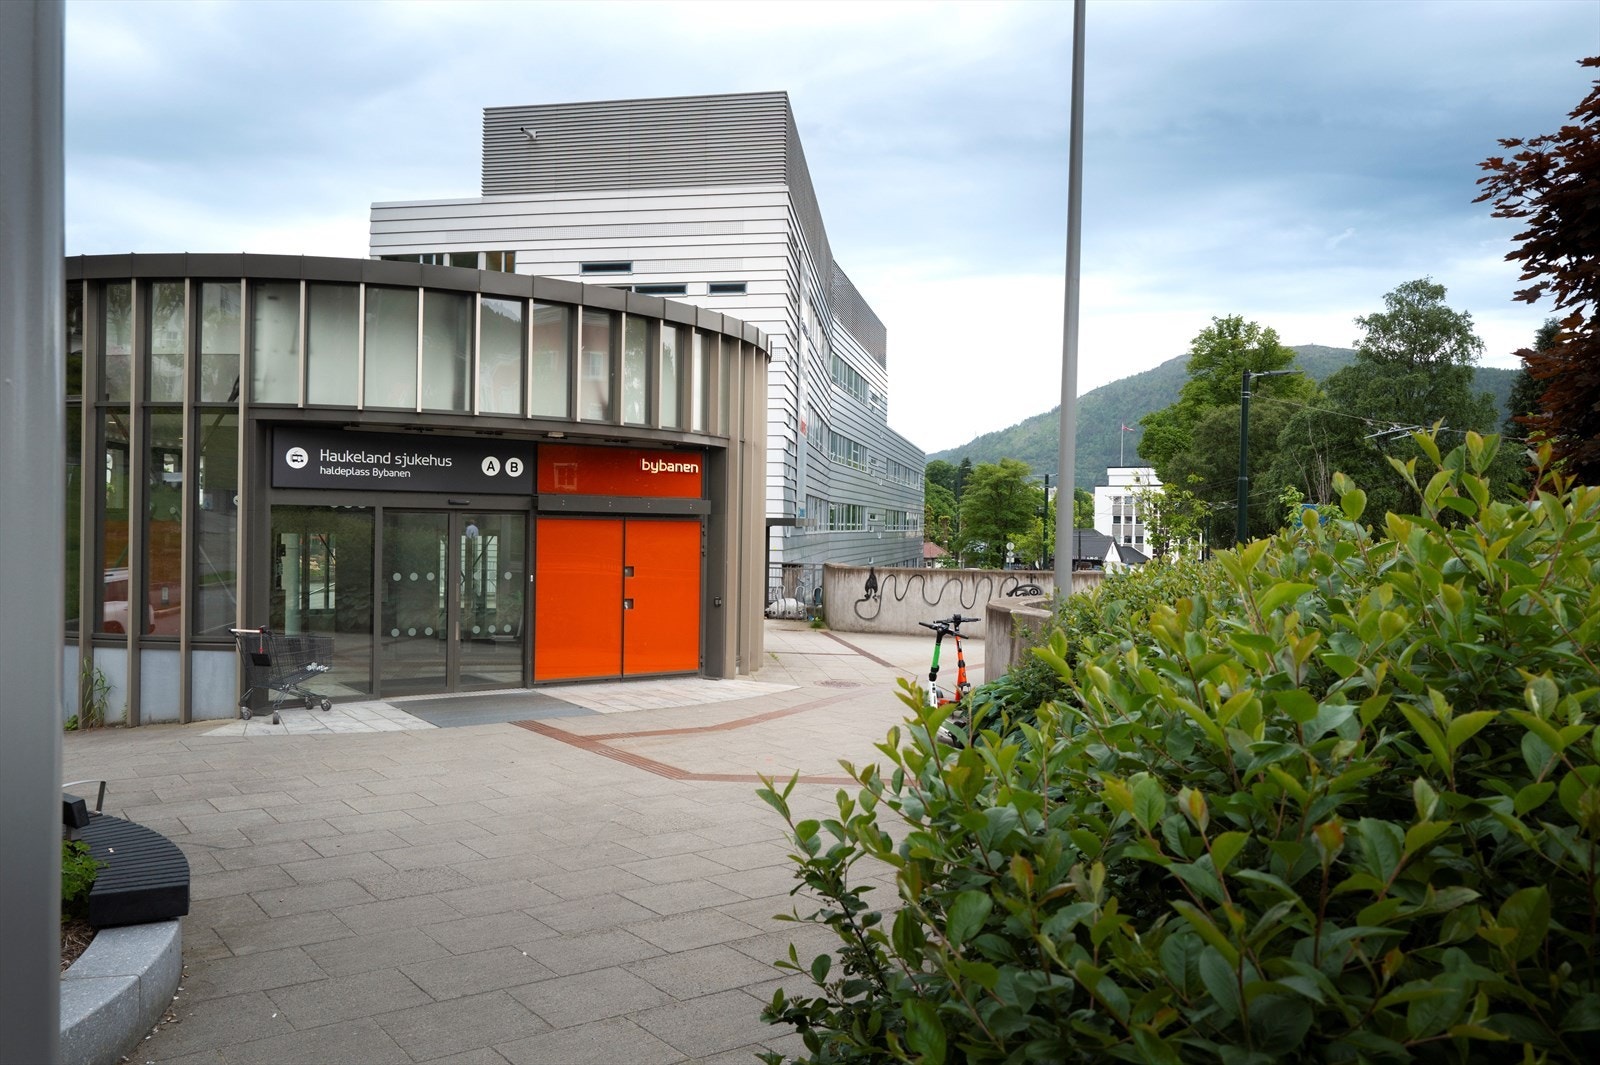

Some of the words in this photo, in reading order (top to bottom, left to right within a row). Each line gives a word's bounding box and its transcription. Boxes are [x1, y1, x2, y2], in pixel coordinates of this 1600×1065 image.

[320, 449, 391, 464] Haukeland
[394, 452, 453, 468] sjukehus
[320, 466, 370, 477] haldeplass
[373, 468, 411, 478] Bybanen
[486, 461, 496, 472] A
[510, 462, 518, 473] B
[641, 458, 699, 474] bybanen
